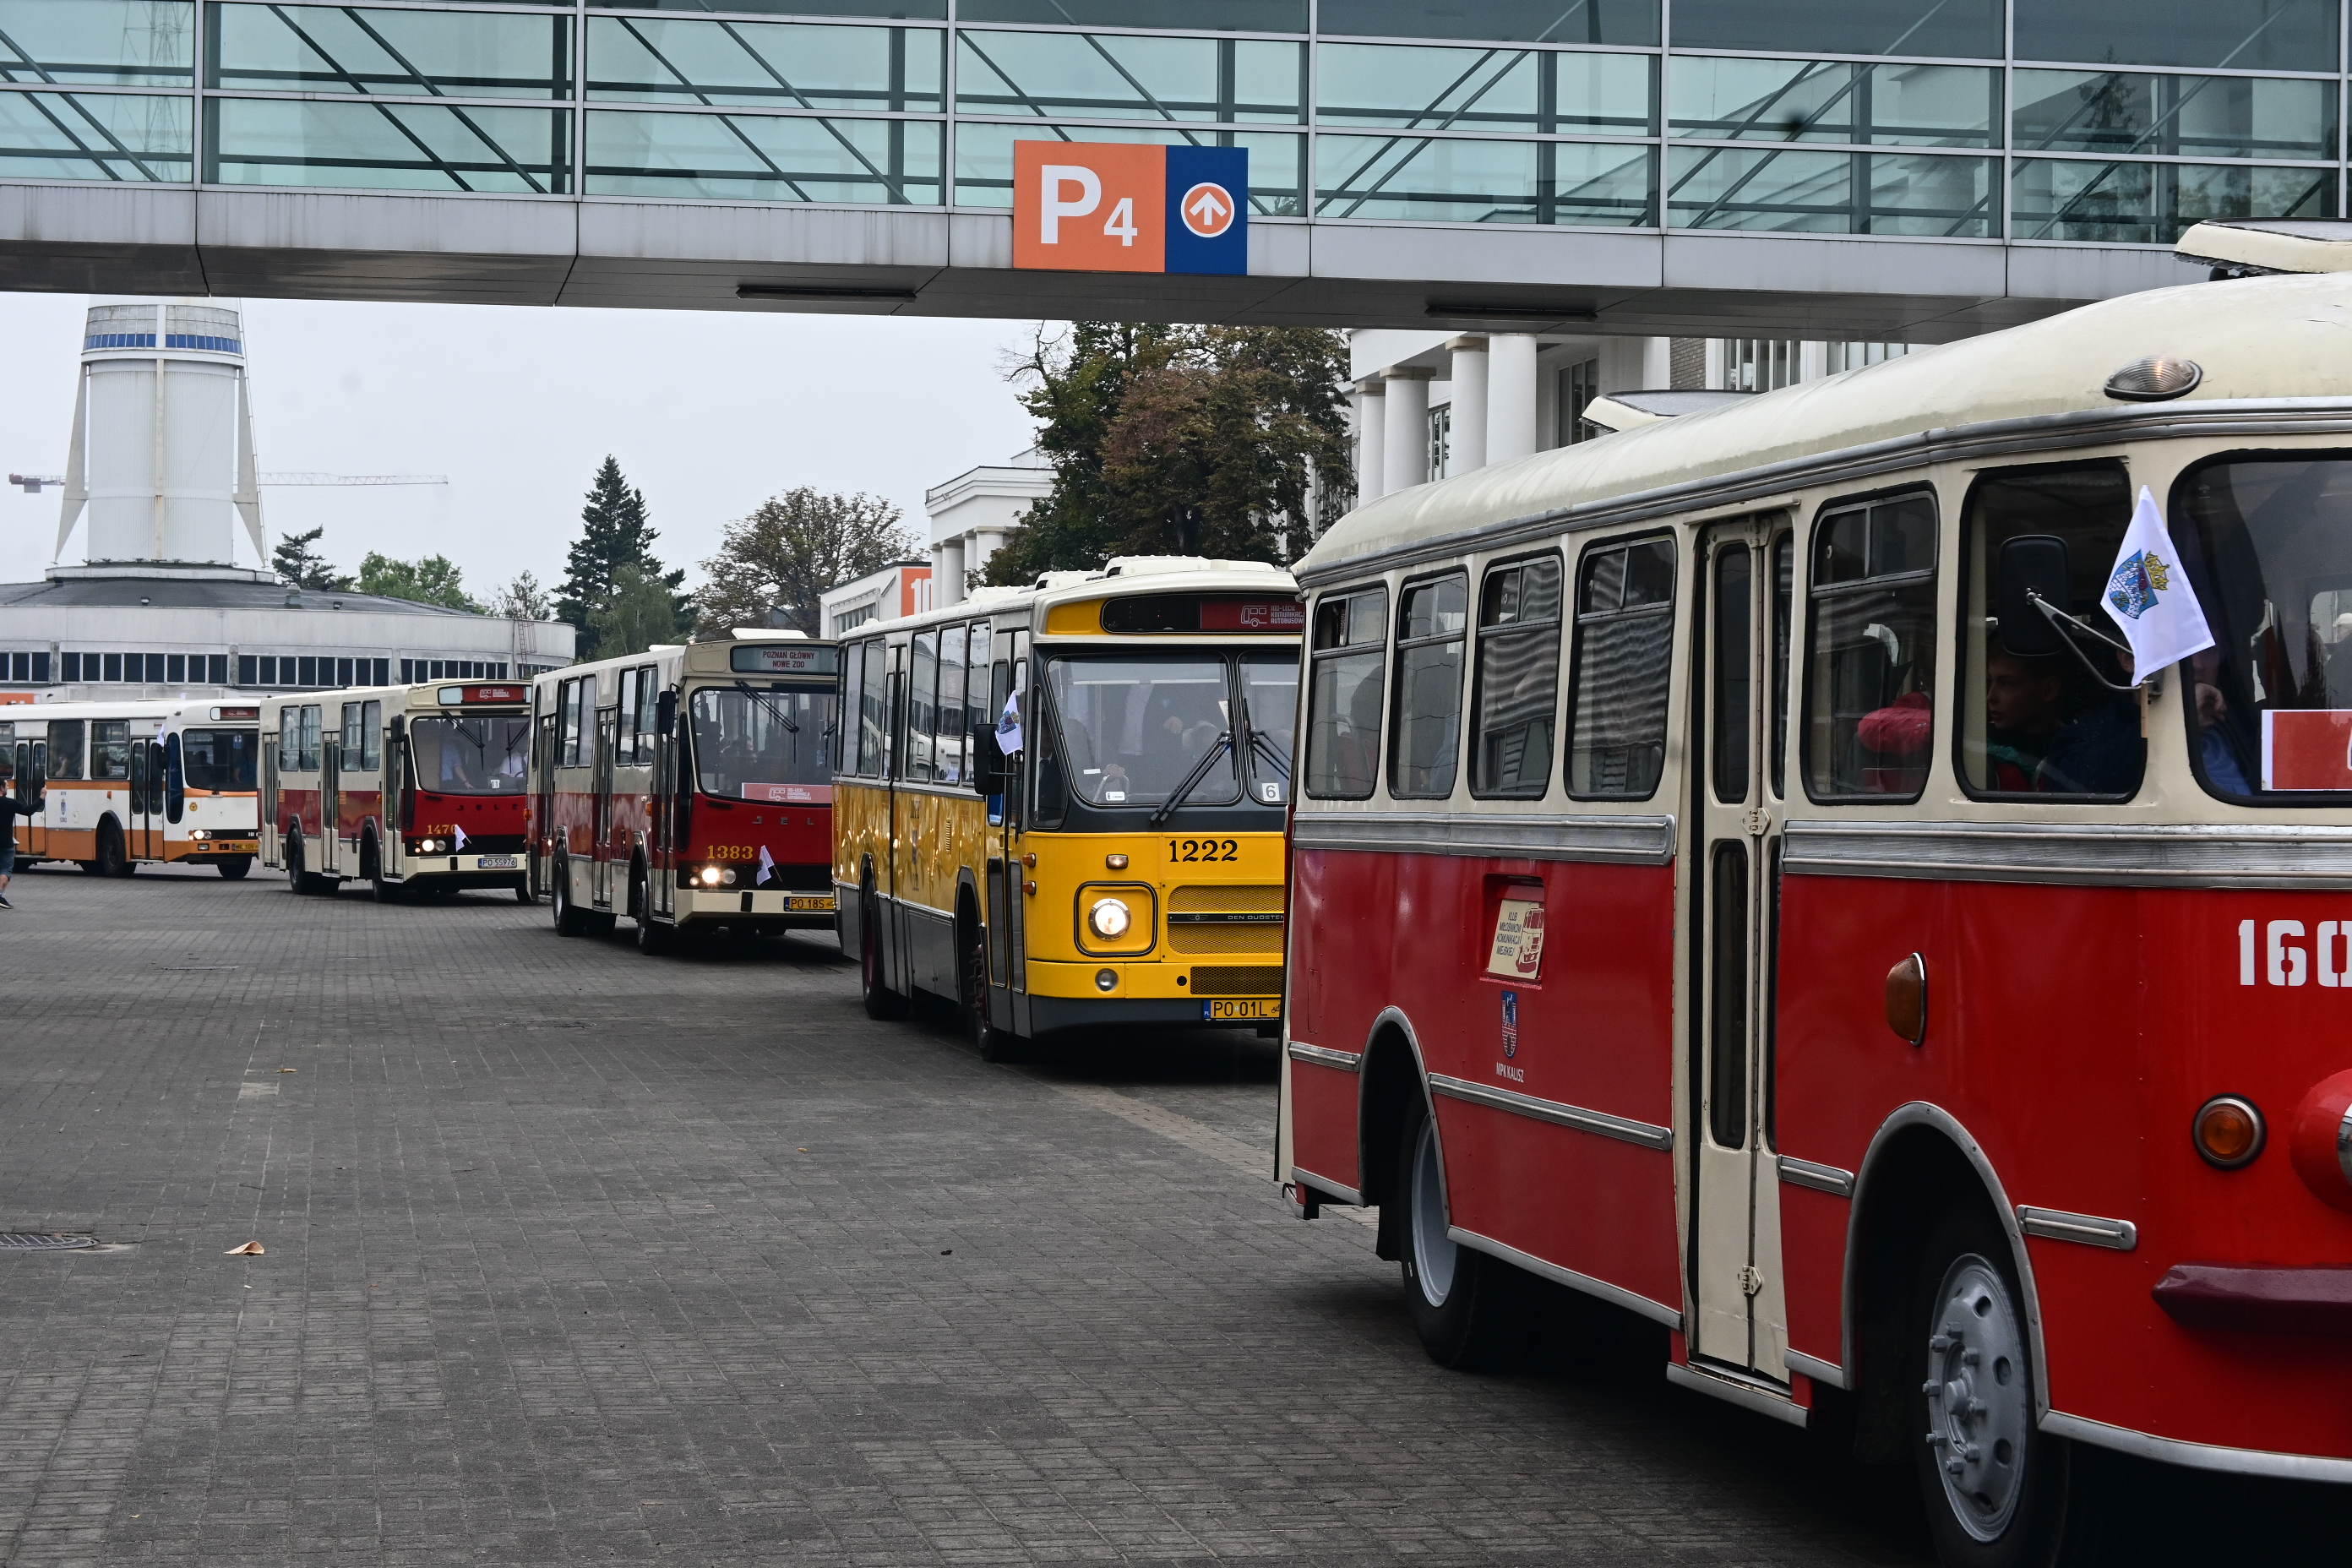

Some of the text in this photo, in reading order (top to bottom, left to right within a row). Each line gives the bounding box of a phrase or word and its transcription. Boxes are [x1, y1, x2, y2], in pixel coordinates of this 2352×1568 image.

[763, 651, 787, 659] POZNAŃ
[1266, 785, 1277, 798] 6
[707, 845, 754, 860] 1383
[1169, 840, 1238, 862] 1222
[2238, 919, 2352, 988] 160
[1213, 1001, 1268, 1017] PO 01L
[1506, 1065, 1524, 1083] KALISZ
